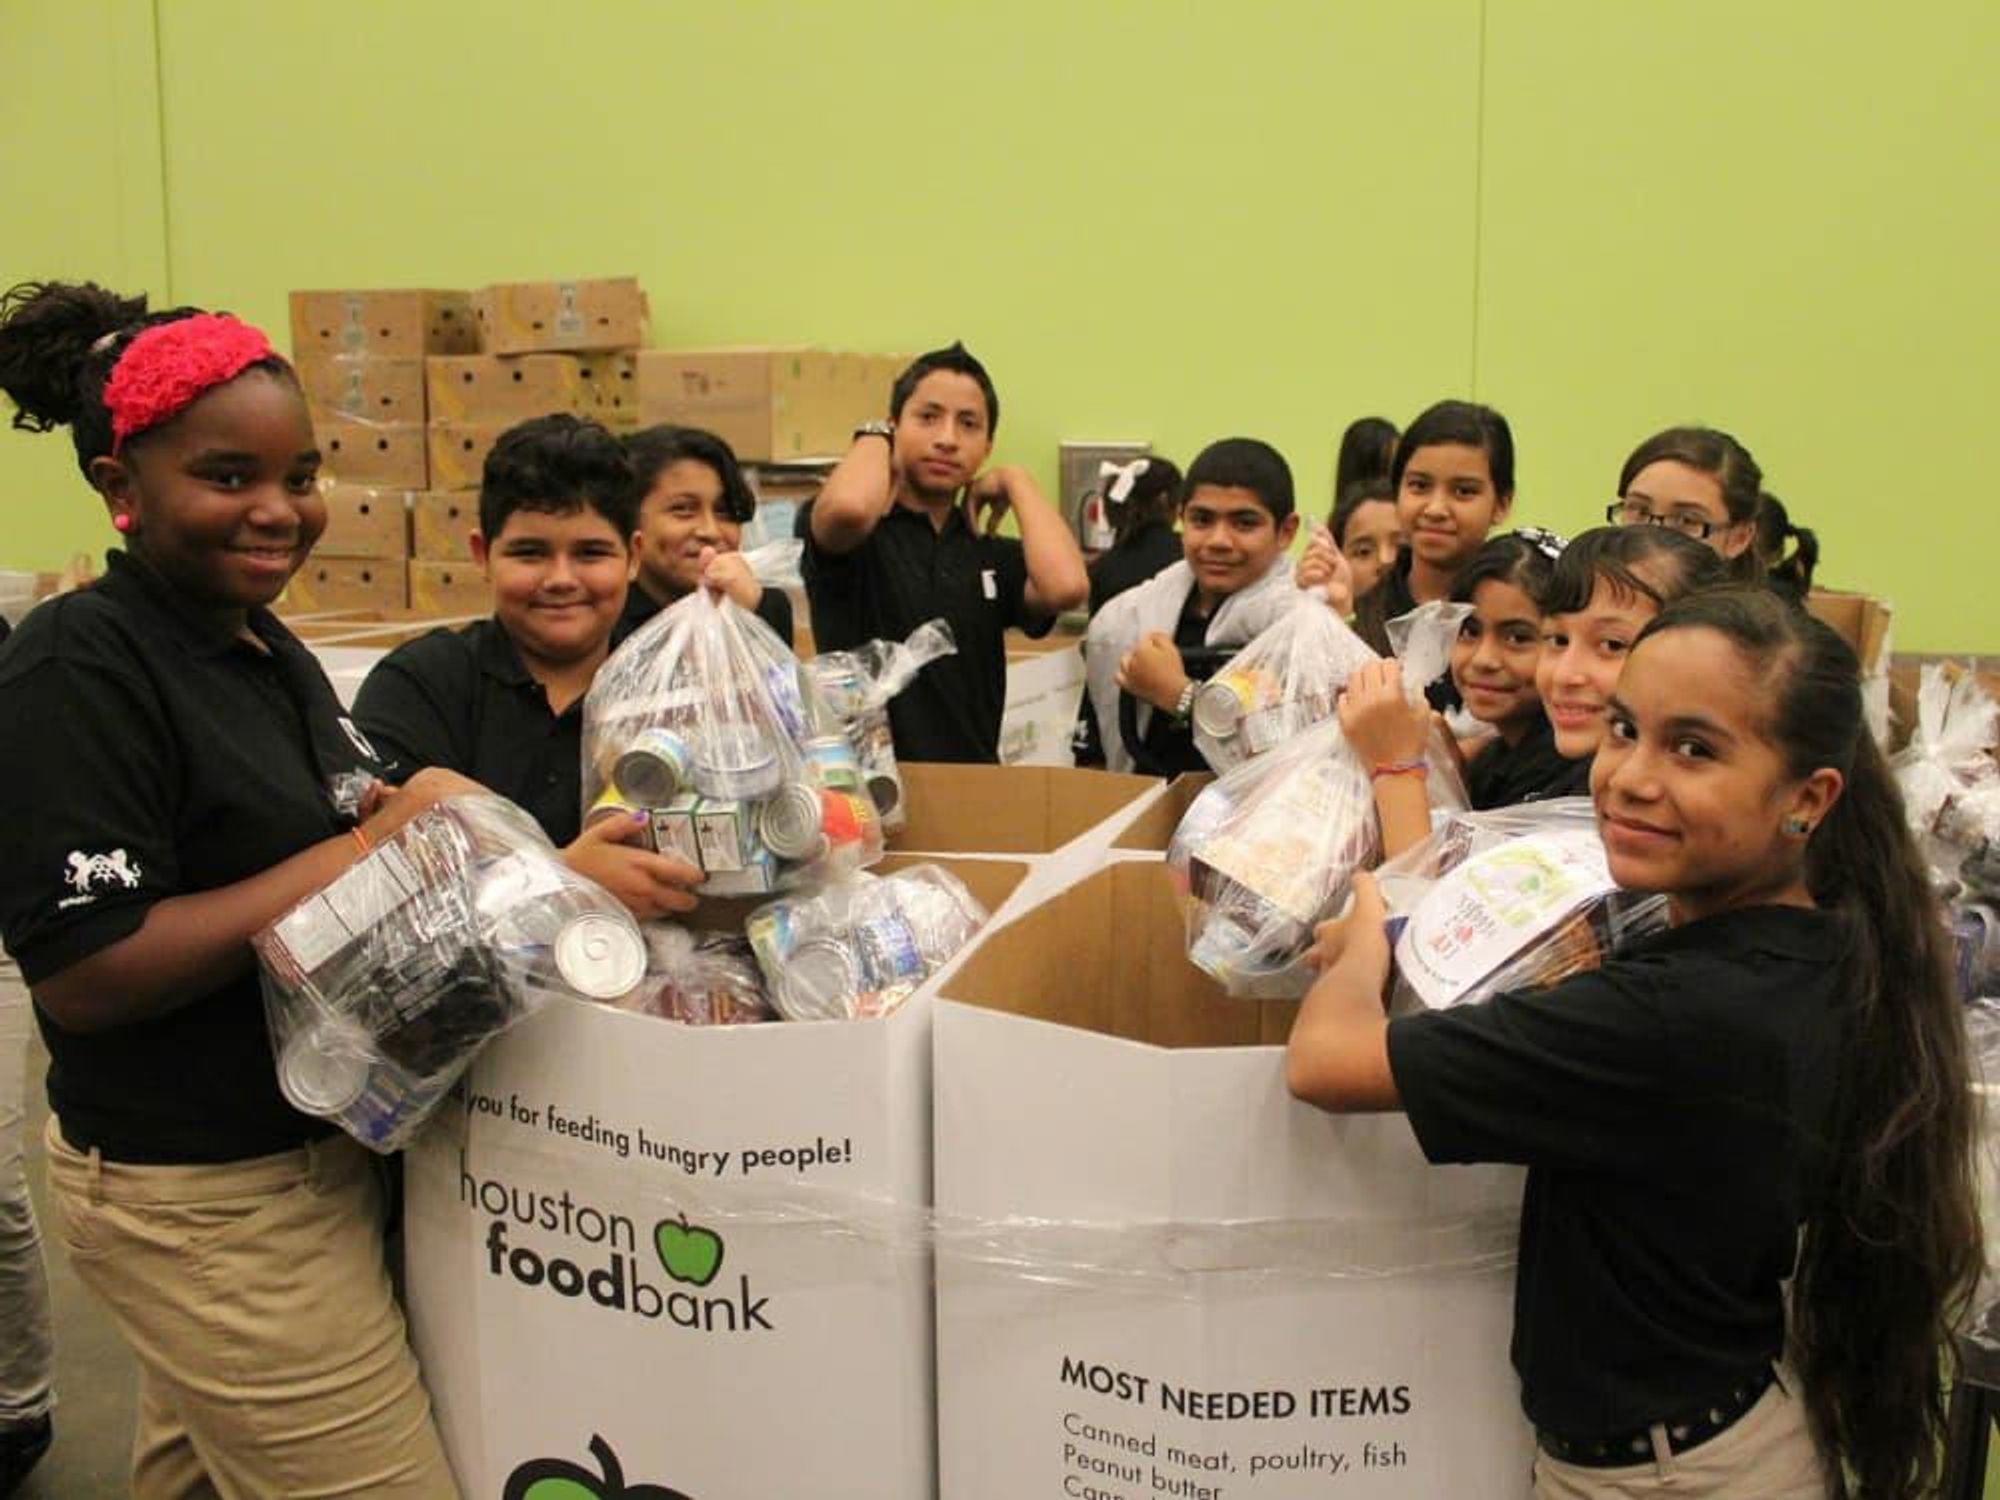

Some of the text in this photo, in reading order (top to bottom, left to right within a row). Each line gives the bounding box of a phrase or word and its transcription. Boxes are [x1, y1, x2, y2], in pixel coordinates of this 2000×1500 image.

[468, 1093, 852, 1175] you for feeding hungry people!
[459, 1148, 636, 1252] houston
[486, 1220, 774, 1332] foodbank
[1060, 1356, 1412, 1420] MOST NEEDED ITEMS
[1063, 1412, 1408, 1475] Canned meat, poultry, fish
[1063, 1443, 1223, 1500] Peanut butter
